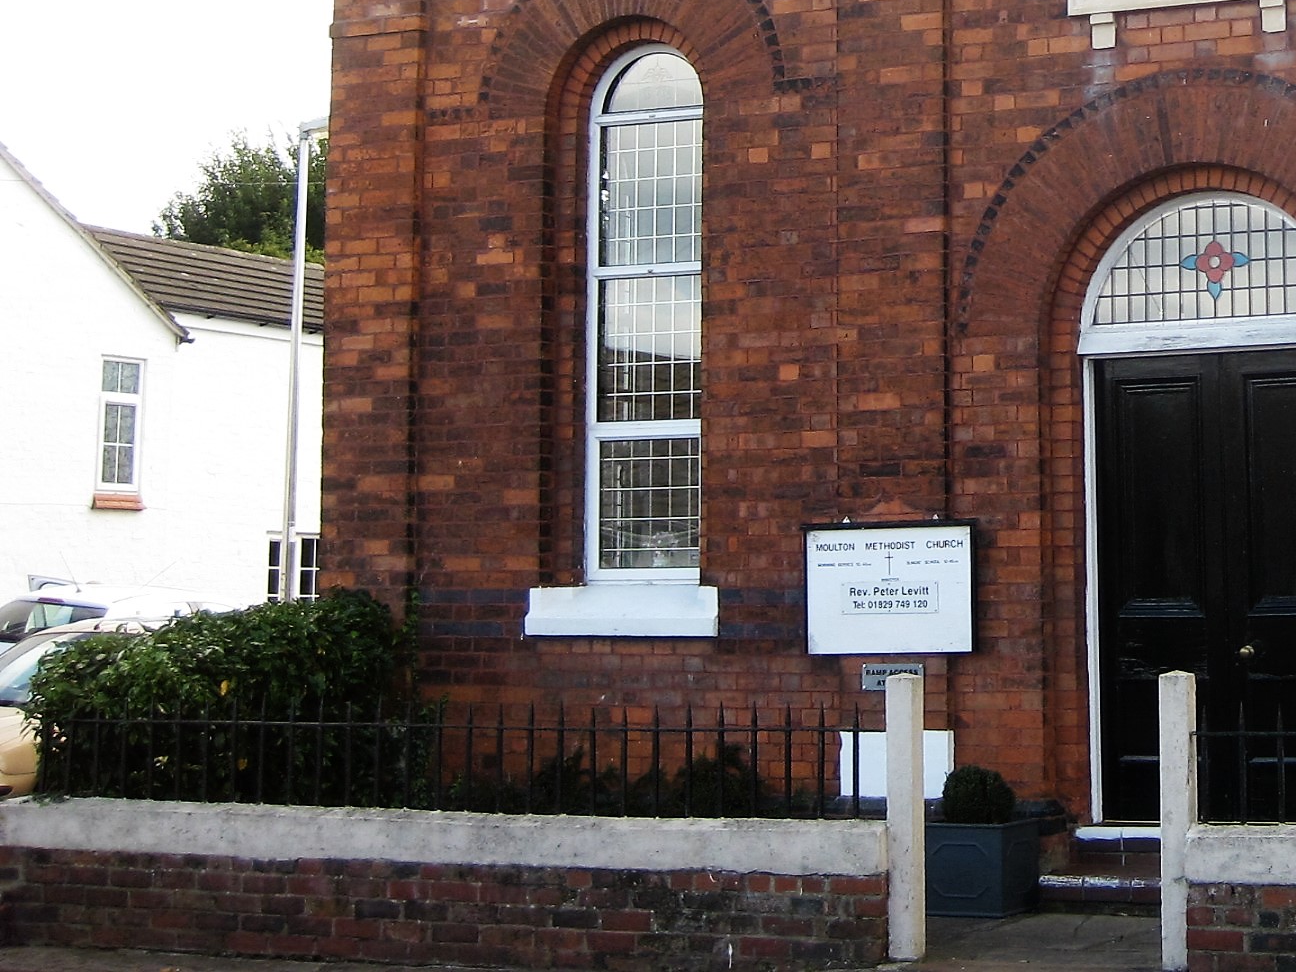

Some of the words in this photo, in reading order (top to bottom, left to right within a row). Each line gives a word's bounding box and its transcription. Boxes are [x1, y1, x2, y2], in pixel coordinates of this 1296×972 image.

[816, 543, 855, 552] MOULTON
[865, 541, 916, 551] METHODIST
[926, 539, 964, 549] CHURCH
[849, 587, 871, 597] Rev.
[873, 586, 899, 596] Peter
[901, 585, 929, 596] Levitt
[895, 600, 910, 609] 749
[913, 599, 928, 608] 120
